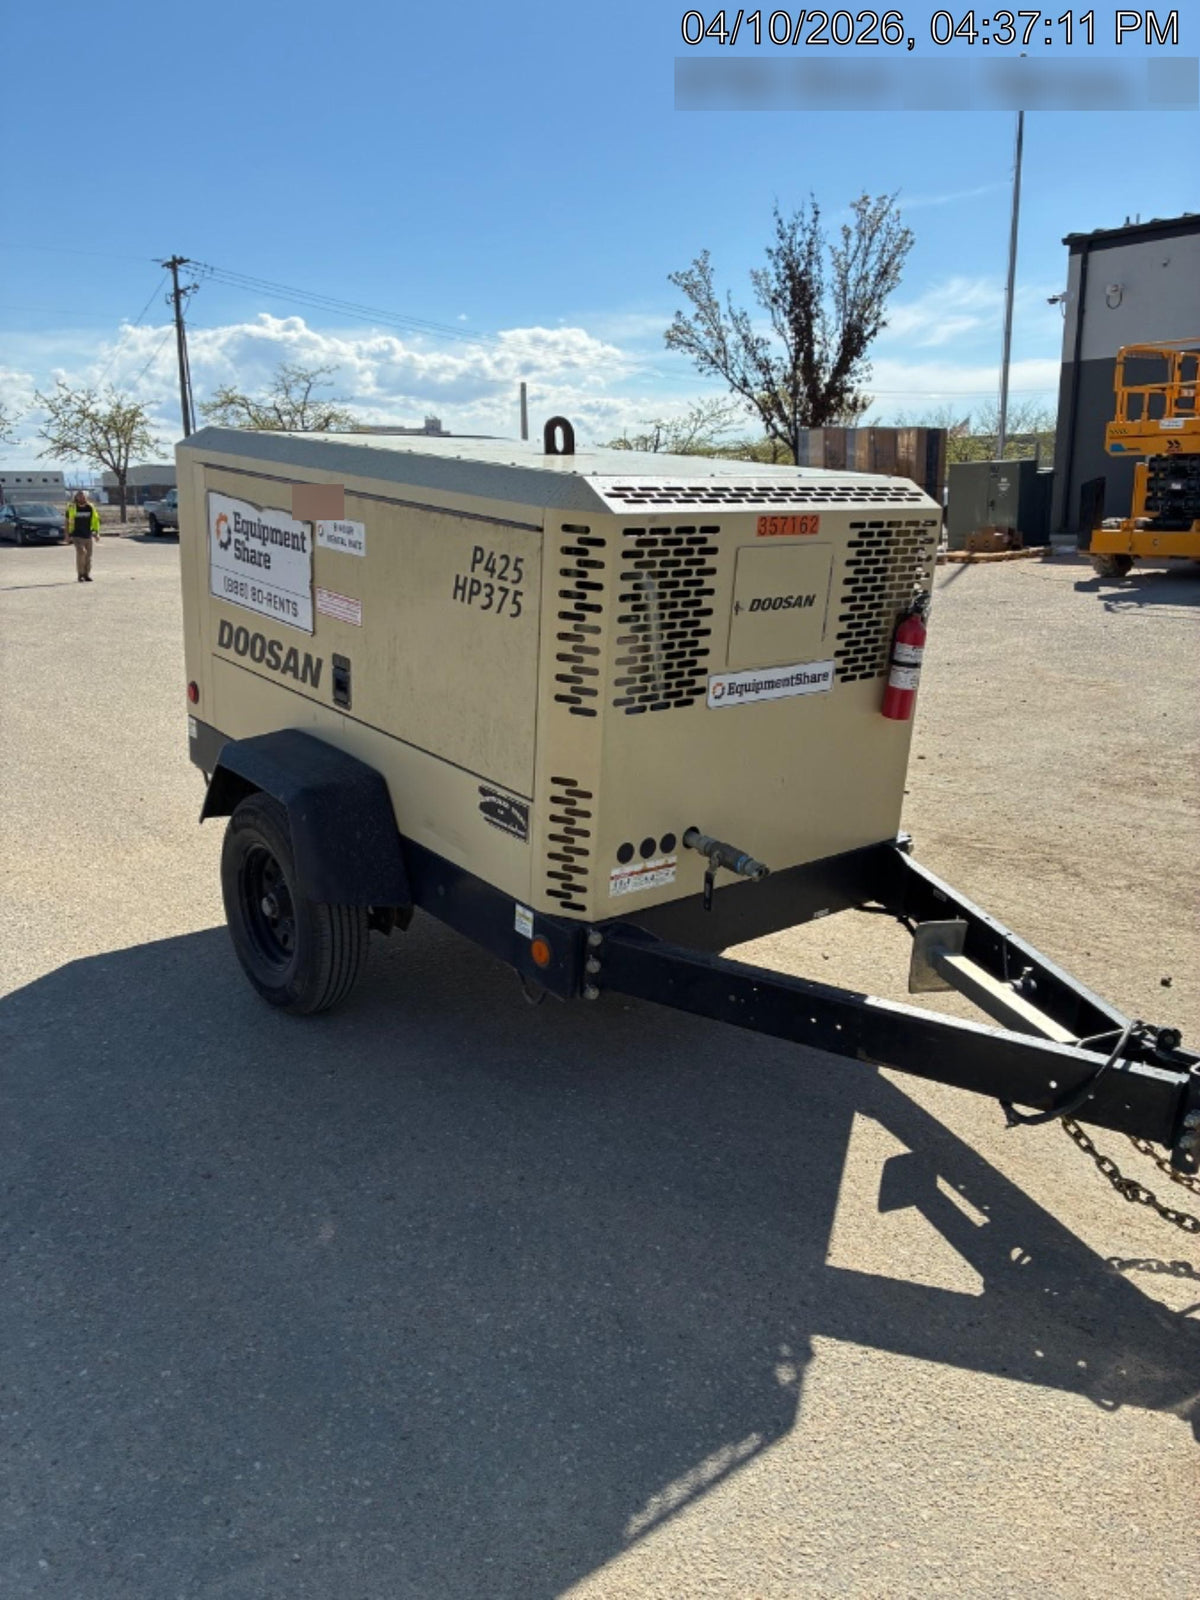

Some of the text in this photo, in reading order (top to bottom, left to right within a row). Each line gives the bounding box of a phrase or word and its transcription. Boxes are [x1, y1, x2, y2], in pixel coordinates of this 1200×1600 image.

[233, 511, 307, 553] Equipment
[757, 515, 819, 535] 357162
[233, 539, 272, 570] Share
[470, 545, 524, 585] P425
[251, 586, 298, 618] 80-RENTS
[453, 573, 523, 618] HP375
[748, 594, 816, 612] DOOSAN
[217, 618, 323, 689] DOOSAN
[726, 670, 830, 697] EquipmentShare
